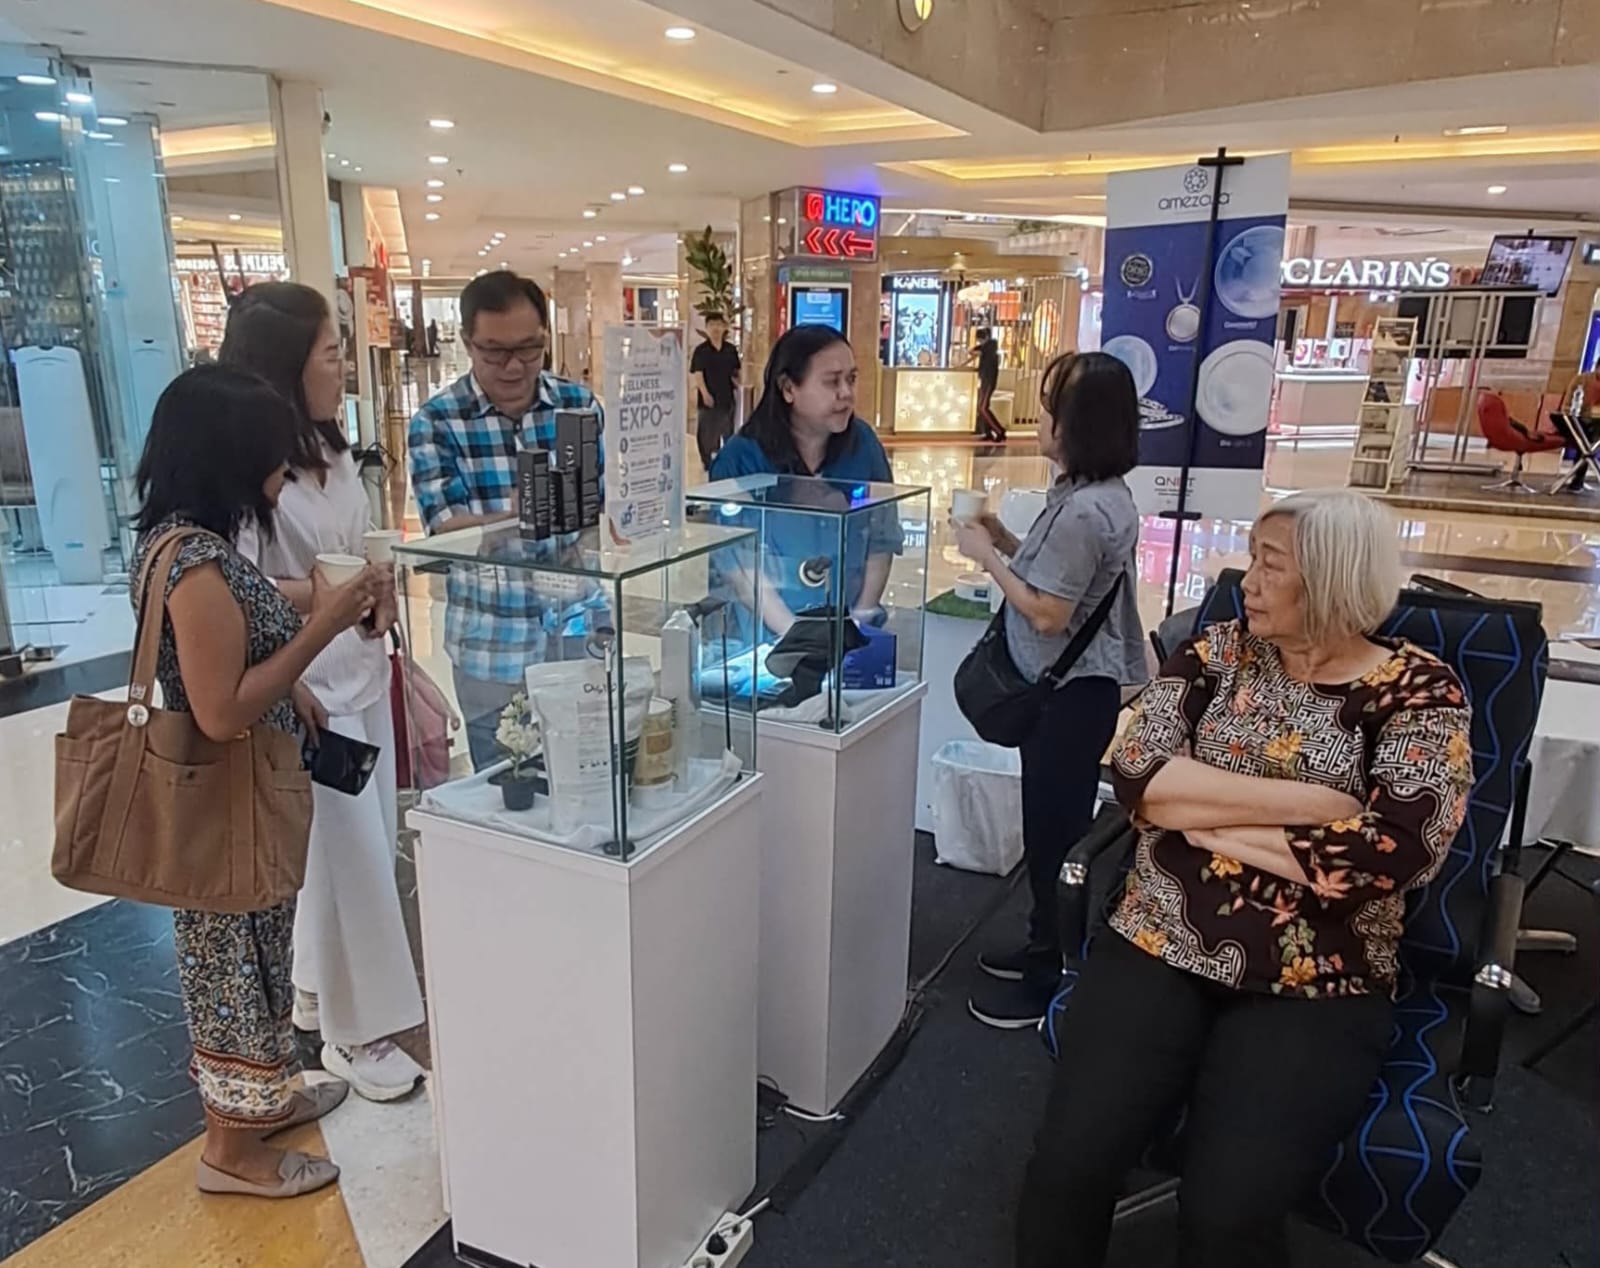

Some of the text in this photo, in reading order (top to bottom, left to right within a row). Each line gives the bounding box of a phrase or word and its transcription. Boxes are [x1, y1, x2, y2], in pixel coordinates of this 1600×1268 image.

[825, 196, 876, 227] HERO
[1158, 193, 1230, 211] amezca
[1284, 257, 1450, 288] CLARINS
[620, 404, 662, 431] EXPO
